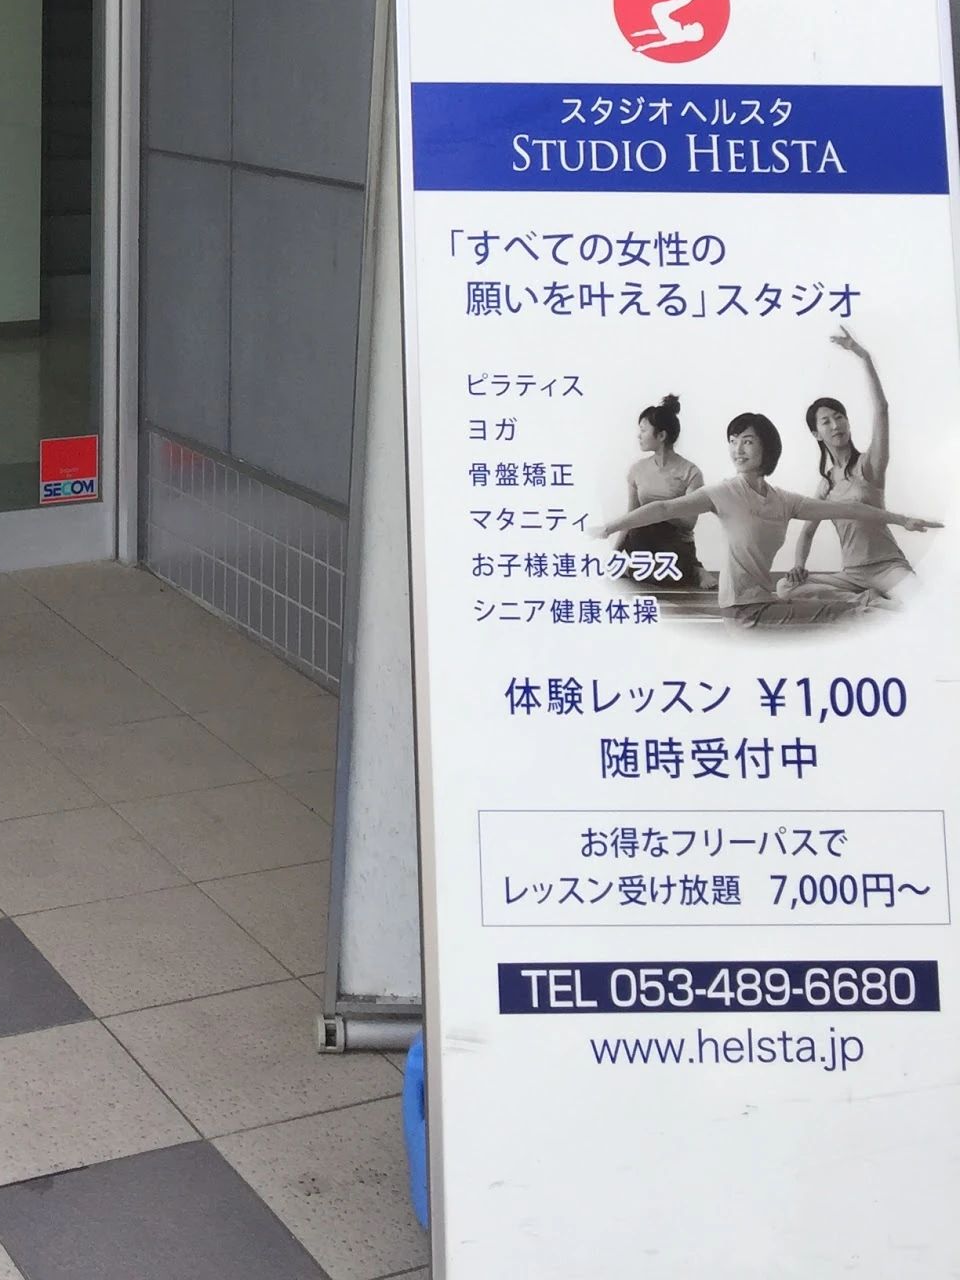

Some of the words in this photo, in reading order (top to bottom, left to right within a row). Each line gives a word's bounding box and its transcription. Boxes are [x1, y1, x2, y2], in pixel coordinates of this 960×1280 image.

[561, 96, 793, 127] スタジオヘルスタ
[451, 229, 727, 268] 「すべての女性の
[466, 281, 862, 318] 願いを叶える」スタジオ
[467, 373, 585, 397] ピラティス
[468, 417, 517, 442] ヨガ
[43, 480, 94, 498] SECOM
[468, 462, 575, 488] 骨盤矯正
[469, 507, 590, 532] マタニティ
[472, 552, 682, 580] お子様連れクラス
[474, 597, 659, 626] シニア健康体操
[505, 677, 732, 716] 体験レッスン
[758, 676, 908, 723] ¥1,000
[601, 737, 819, 780] 随時受付中
[581, 826, 848, 858] お得なフリーパスで
[505, 875, 742, 907] レッスン受け放題
[520, 970, 598, 1009] TEL
[610, 967, 917, 1008] 053-489-6680
[591, 1028, 865, 1072] www.helsta.jp
